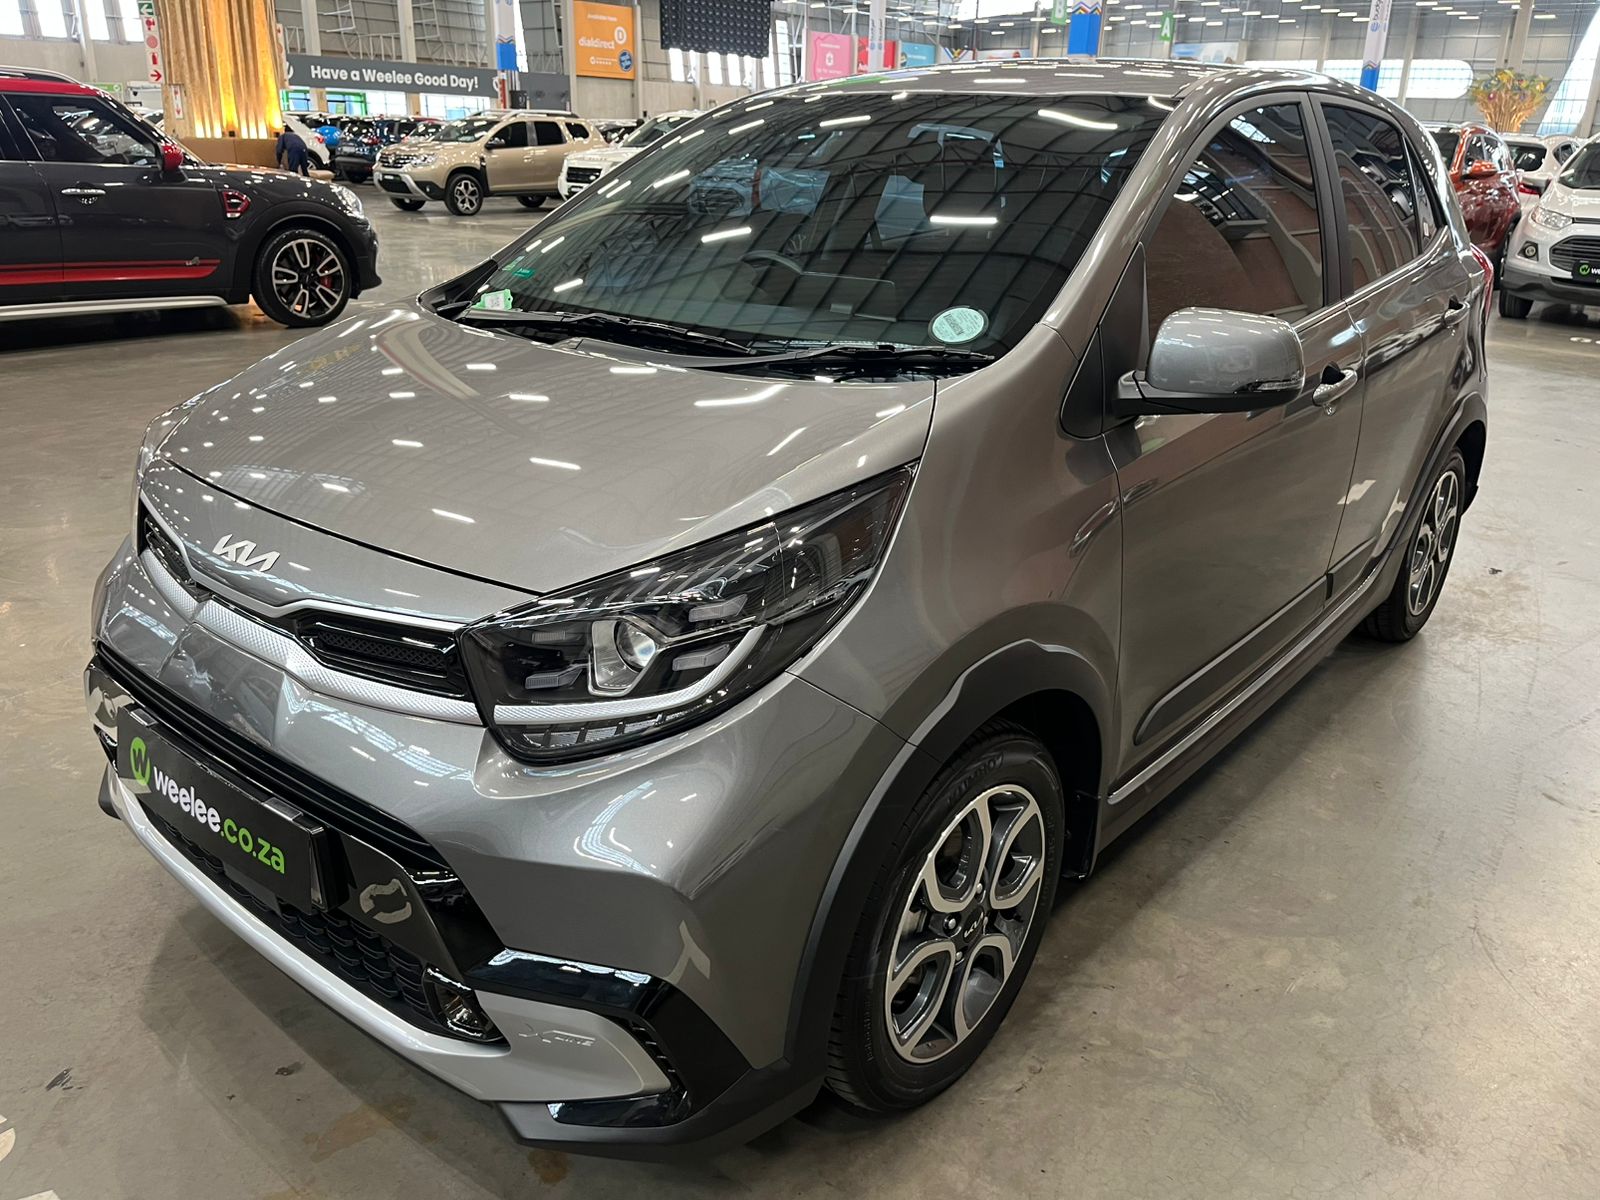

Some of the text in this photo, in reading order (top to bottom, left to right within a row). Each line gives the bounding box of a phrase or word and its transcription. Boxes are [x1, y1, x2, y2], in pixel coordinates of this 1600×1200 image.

[1161, 17, 1170, 37] A
[310, 65, 479, 92] Have a Weelee Good Day!
[212, 533, 280, 572] KIA
[153, 766, 286, 874] weelee.co.za
